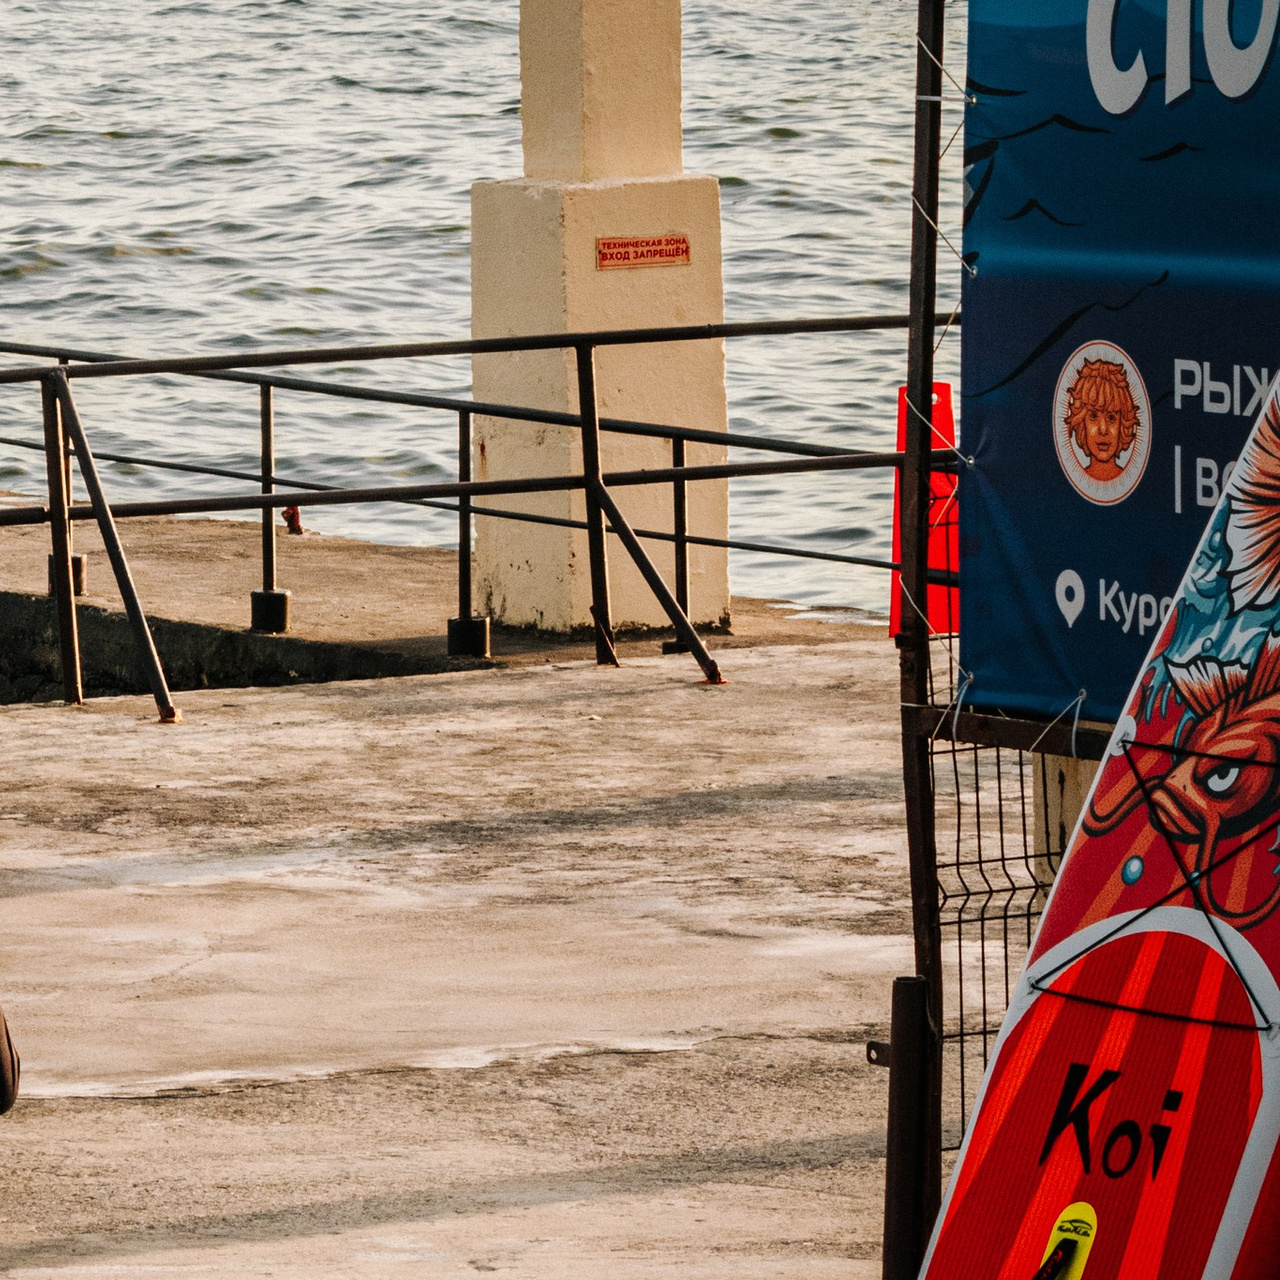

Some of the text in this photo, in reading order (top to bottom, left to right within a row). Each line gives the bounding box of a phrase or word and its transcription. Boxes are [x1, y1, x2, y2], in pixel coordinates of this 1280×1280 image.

[602, 237, 687, 250] ТЕХНИЧЕСКАЯ ЗОНА
[602, 251, 630, 261] ВХОД
[1038, 1063, 1183, 1181] Koi
